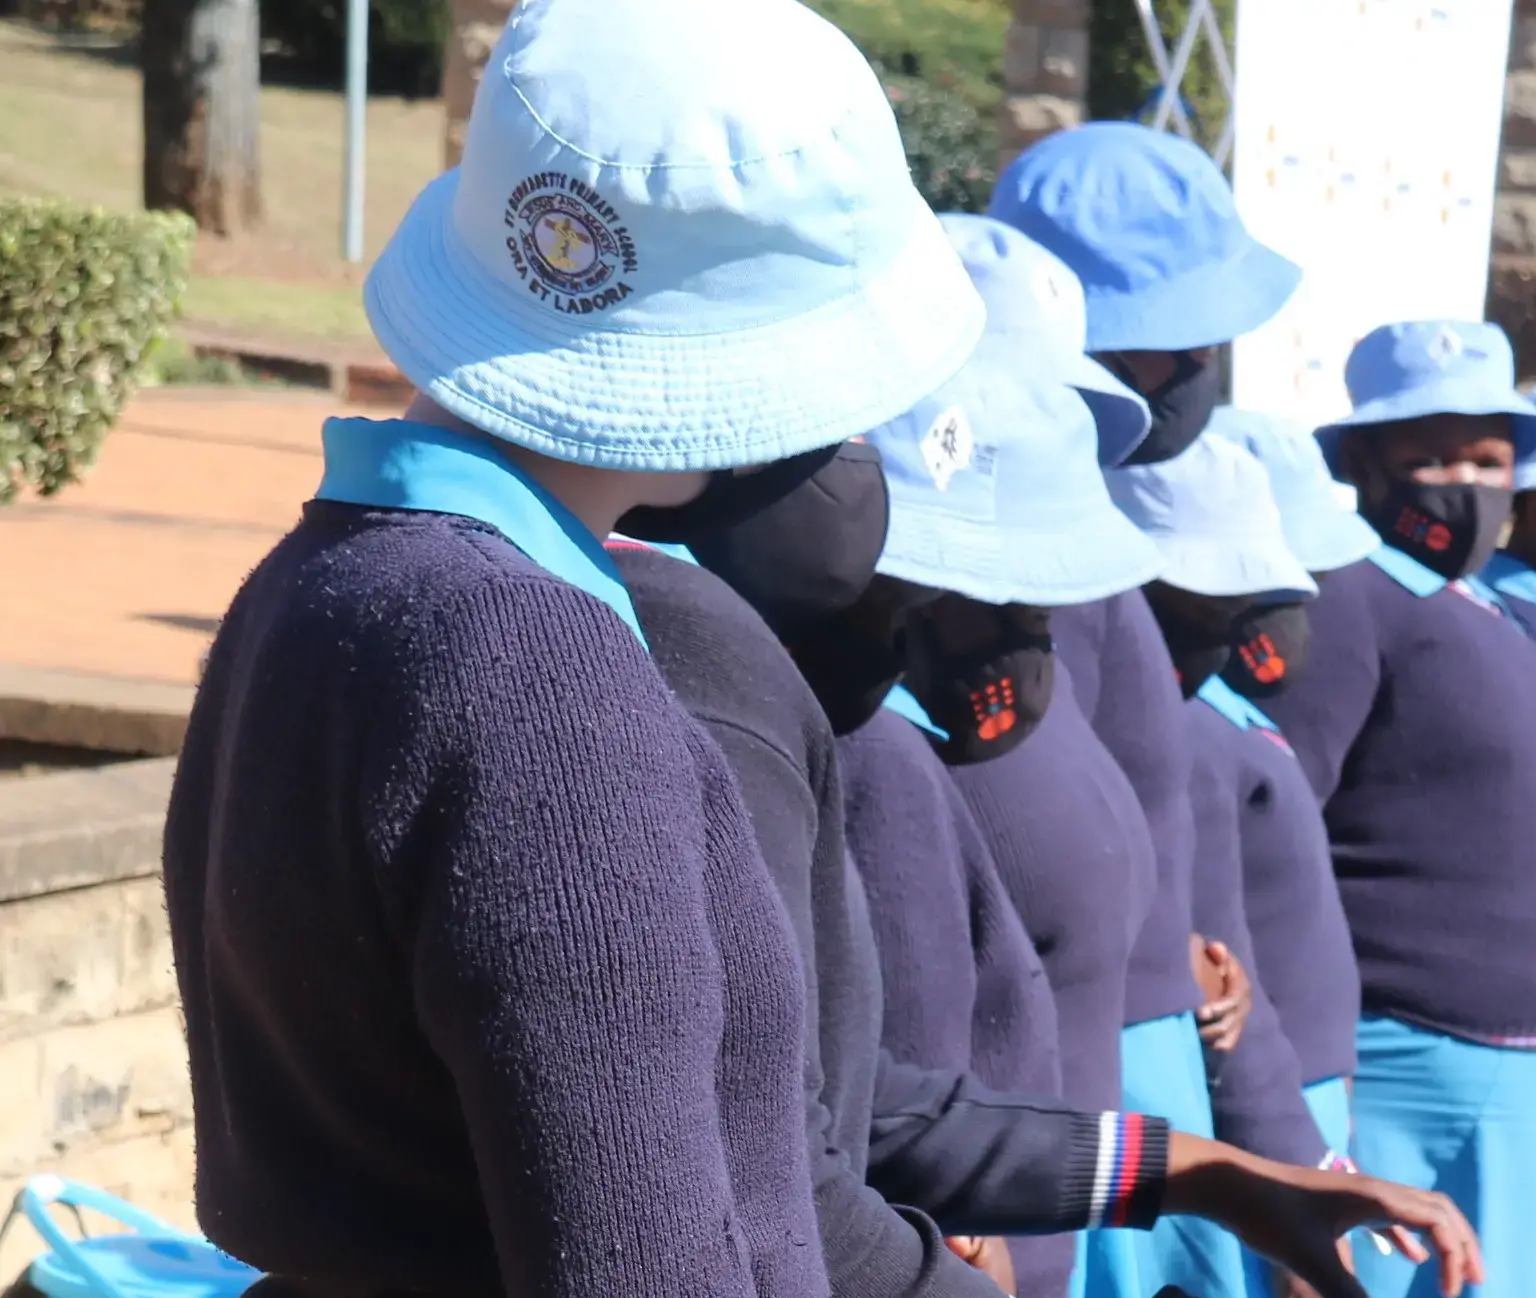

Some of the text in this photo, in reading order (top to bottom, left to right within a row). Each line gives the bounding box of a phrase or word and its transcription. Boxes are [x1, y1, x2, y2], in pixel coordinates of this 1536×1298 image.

[569, 177, 620, 224] PRIMARY
[613, 226, 638, 274] SCHOOL
[529, 278, 552, 302] ET
[554, 281, 635, 315] LABORA
